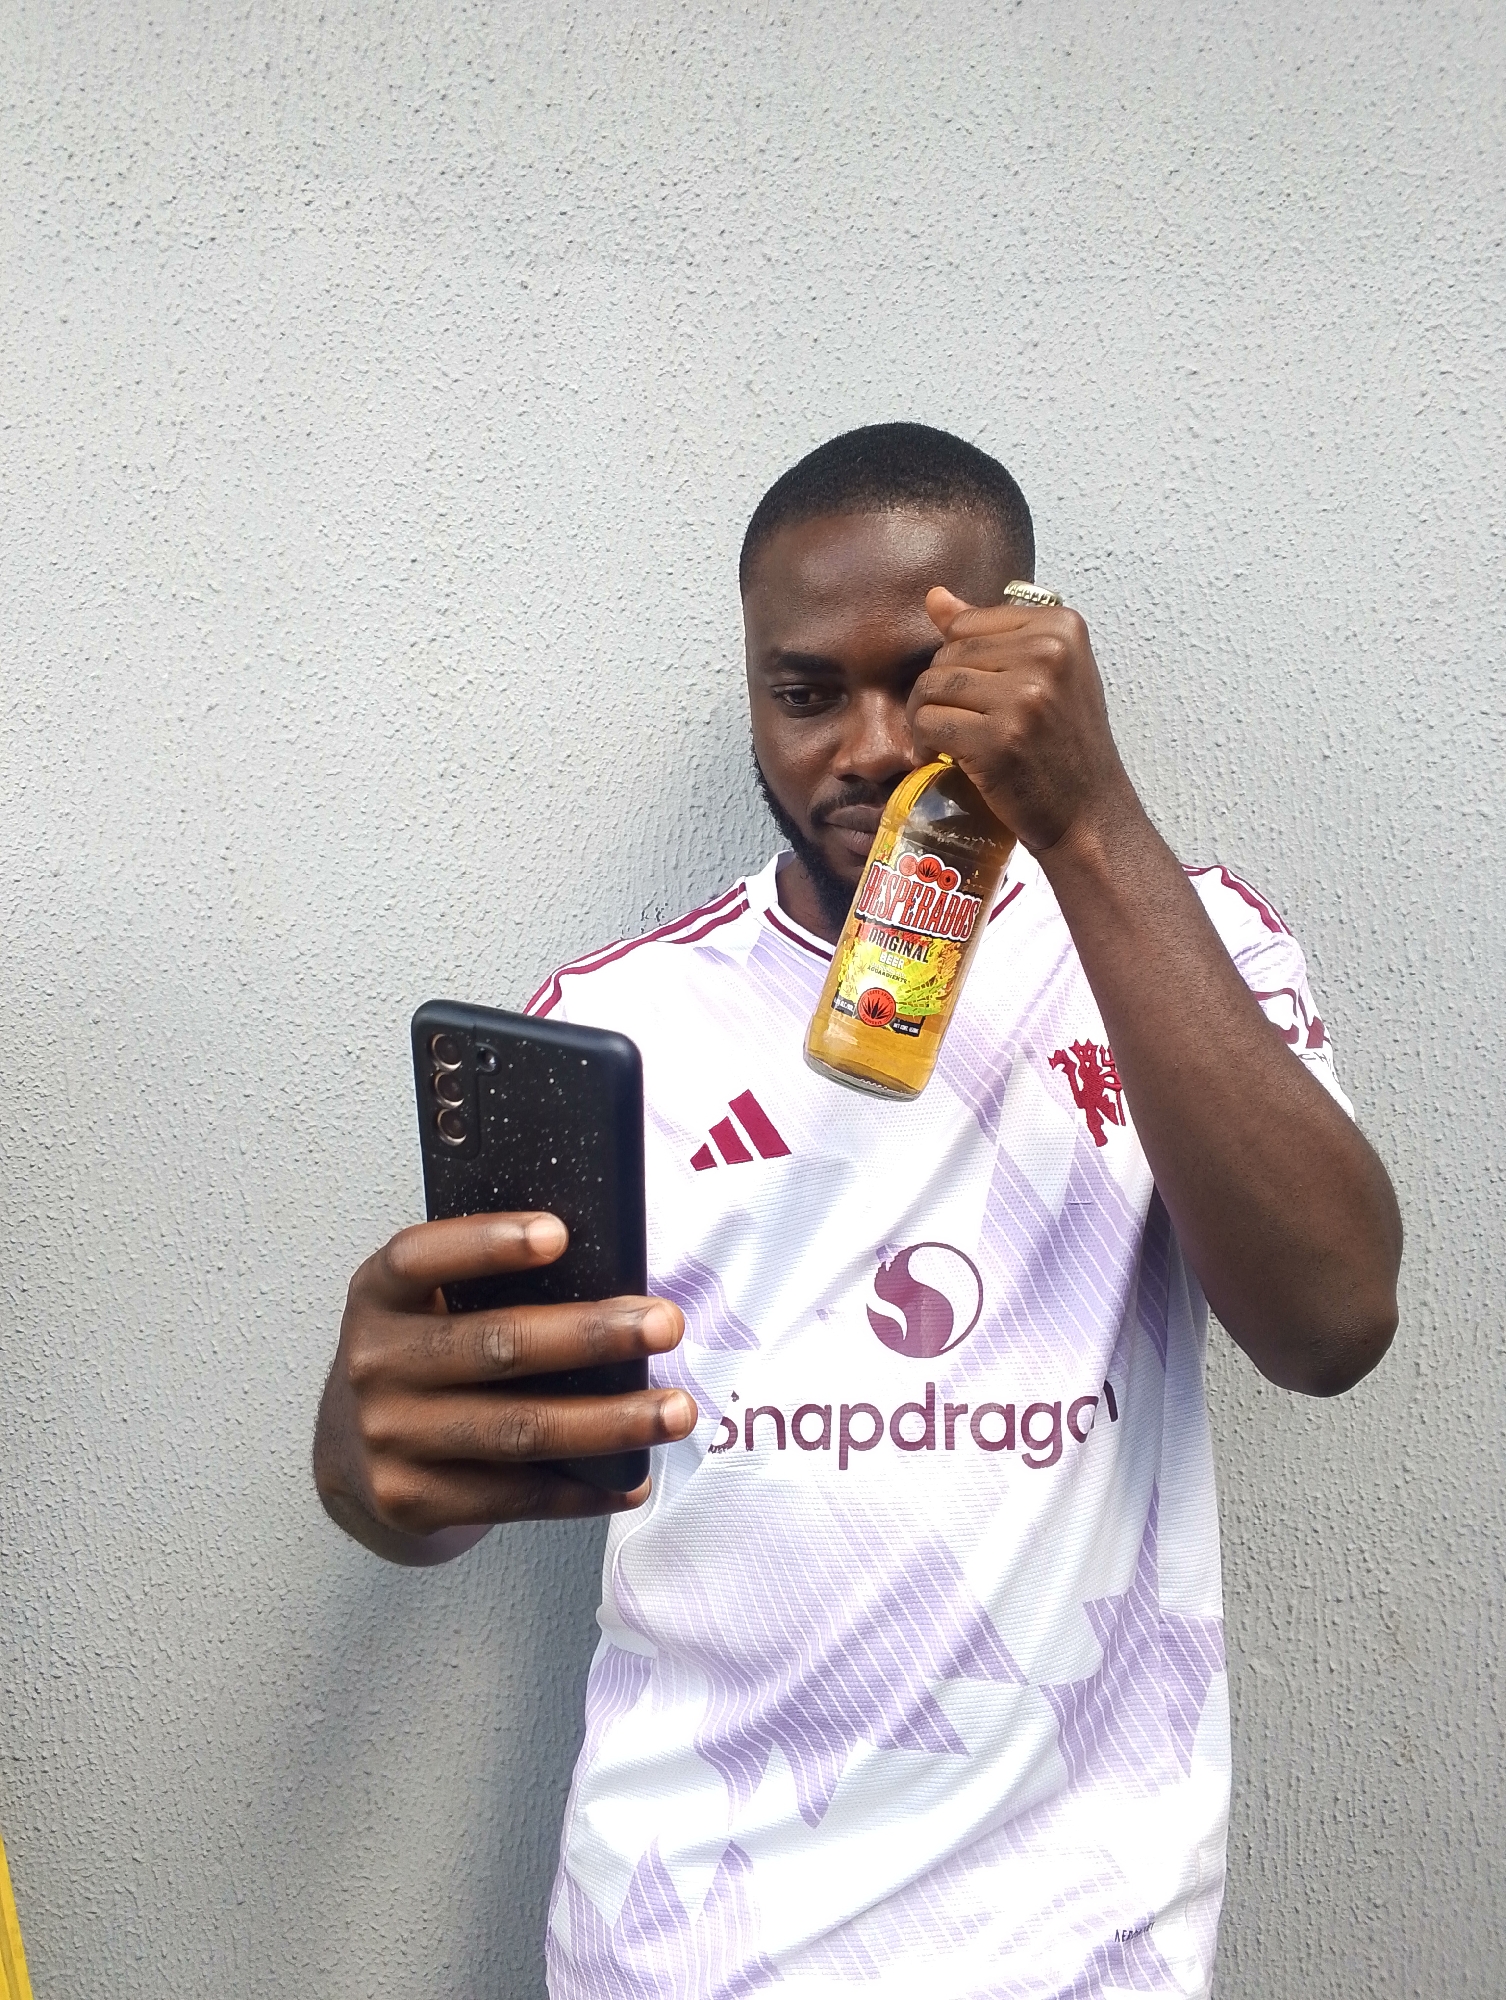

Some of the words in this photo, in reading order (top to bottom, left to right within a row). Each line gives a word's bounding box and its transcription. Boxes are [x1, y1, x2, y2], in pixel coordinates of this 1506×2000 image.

[857, 864, 981, 939] DESPERADOS
[868, 926, 929, 963] ORIGINAL
[879, 951, 905, 970] BEER
